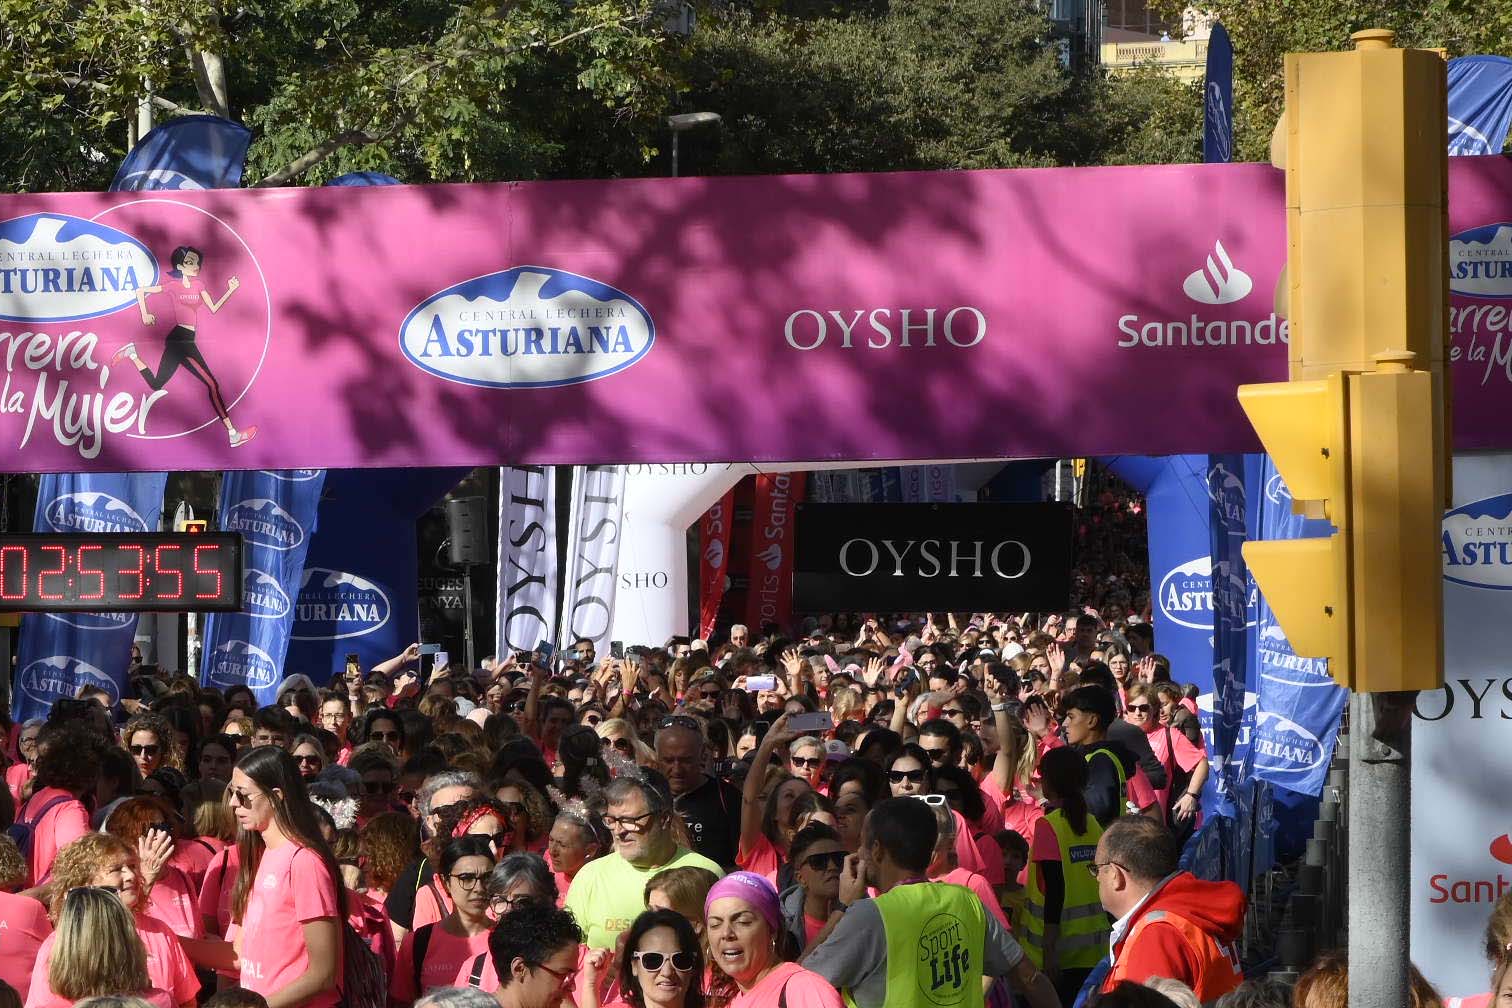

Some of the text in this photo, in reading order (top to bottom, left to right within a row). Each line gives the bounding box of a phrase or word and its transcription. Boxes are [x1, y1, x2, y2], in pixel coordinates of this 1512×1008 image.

[62, 250, 134, 261] LECHERA
[460, 307, 625, 321] CENTRAL LECHERA
[785, 307, 986, 350] OYSHO
[1118, 314, 1289, 347] Santande
[419, 315, 634, 358] ASTURIANA
[0, 373, 24, 414] la
[20, 365, 168, 459] Mujer
[53, 504, 145, 532] ASTURIAN
[765, 472, 791, 538] Santa
[228, 511, 295, 545] ASTURIANA
[1465, 527, 1512, 537] CENTR
[504, 467, 548, 651] OYSH
[570, 465, 619, 643] OYSH
[839, 538, 1032, 579] OYSHO
[1, 545, 222, 600] 02:53:55
[619, 571, 668, 589] SHO
[1183, 581, 1211, 589] CENT
[296, 604, 381, 622] TURIANA
[1263, 651, 1329, 678] TURIAN
[1254, 738, 1314, 763] URIANA
[920, 921, 963, 962] Sport
[930, 943, 969, 991] Life
